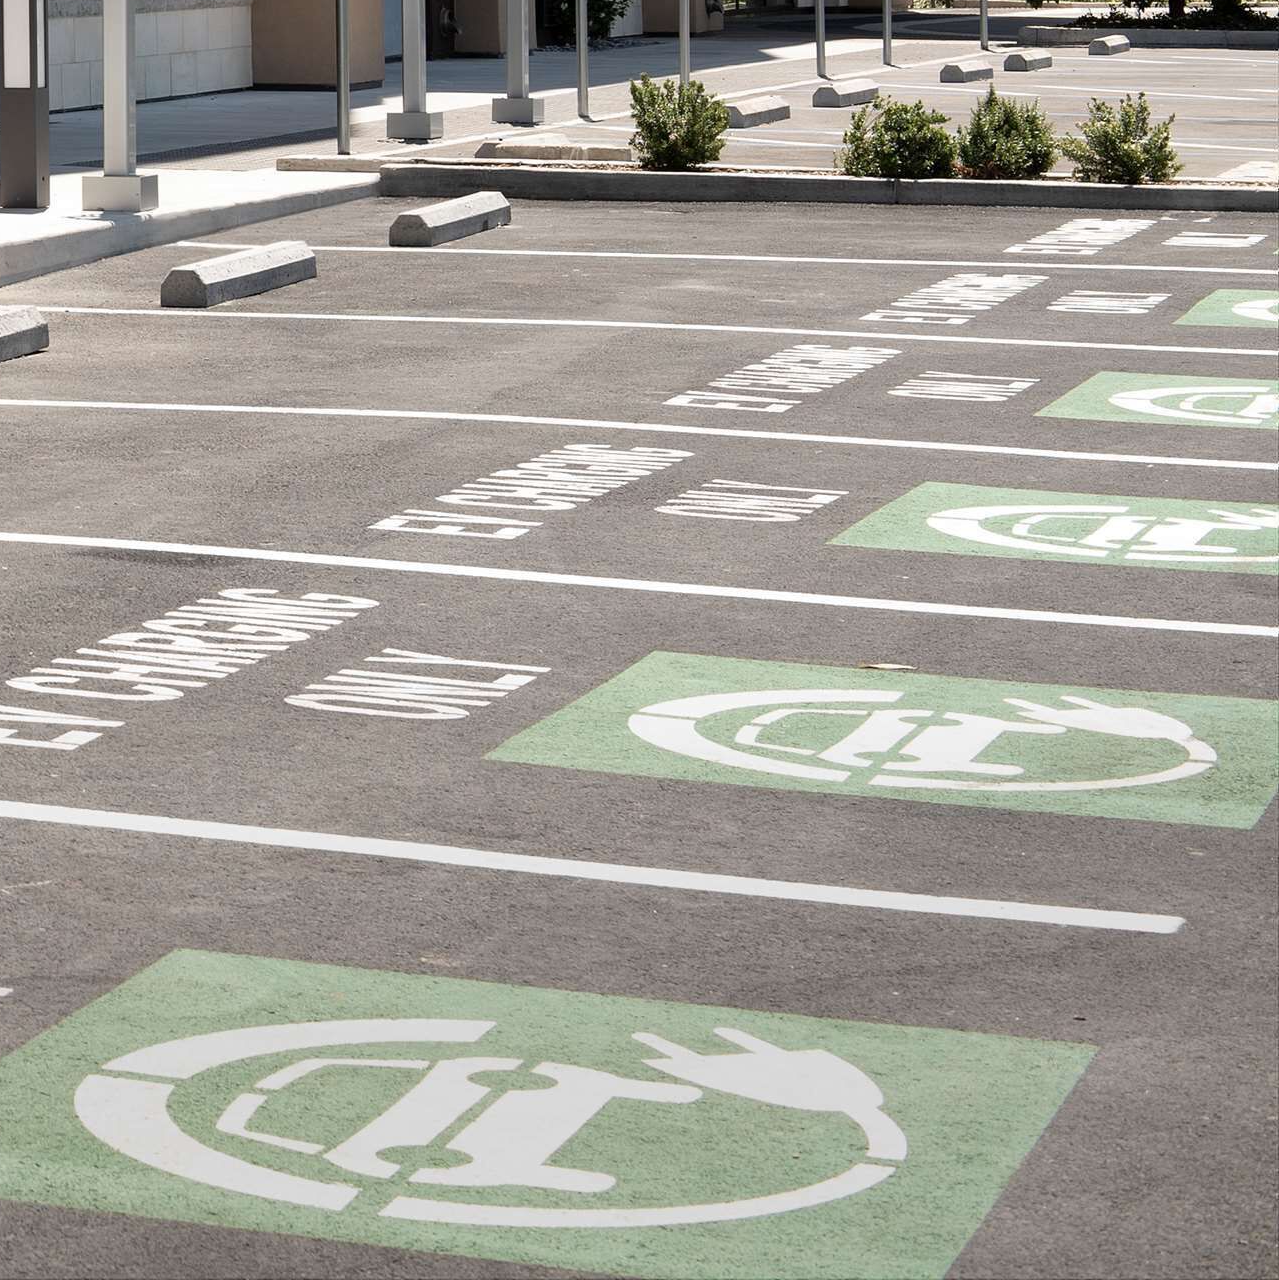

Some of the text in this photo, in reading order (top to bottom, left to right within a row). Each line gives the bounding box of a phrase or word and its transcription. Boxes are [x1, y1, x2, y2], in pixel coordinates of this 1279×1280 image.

[662, 344, 903, 413] EV CHARGING
[886, 370, 1041, 402] ONLY
[367, 443, 696, 540] EV CHARGING
[653, 478, 850, 522] ONLY
[5, 587, 381, 702] CHARGING
[283, 647, 552, 720] ONLY
